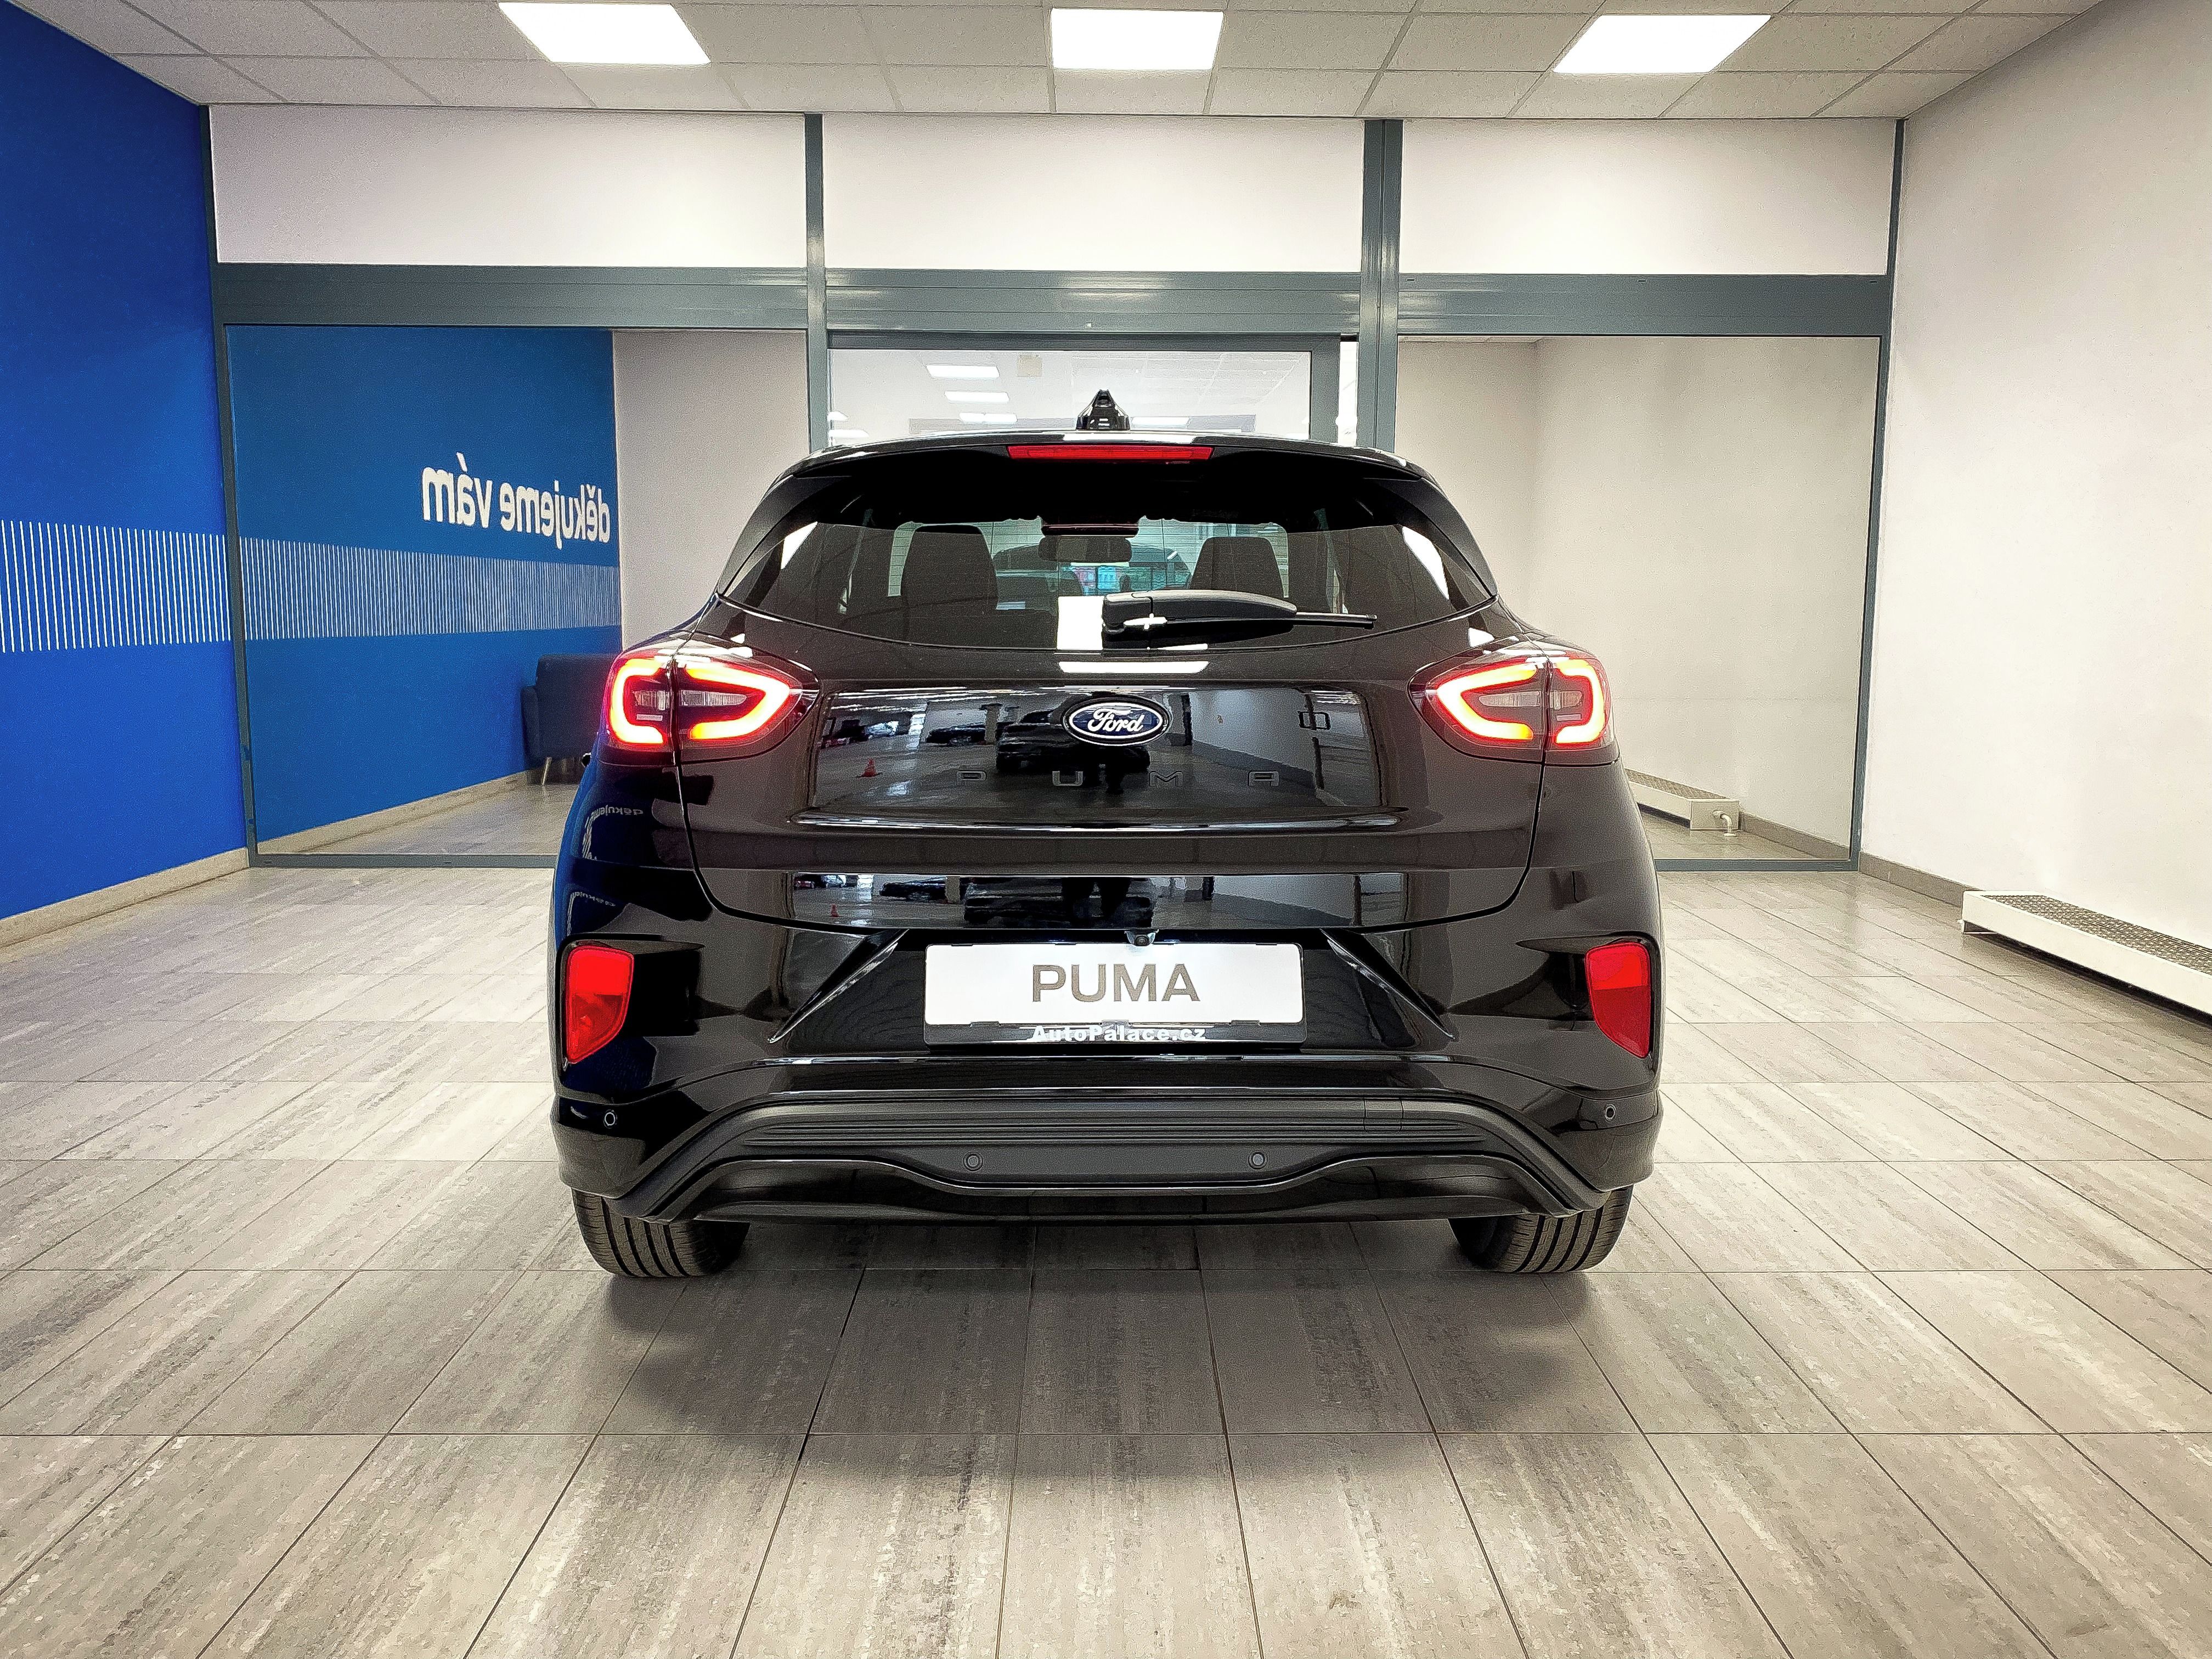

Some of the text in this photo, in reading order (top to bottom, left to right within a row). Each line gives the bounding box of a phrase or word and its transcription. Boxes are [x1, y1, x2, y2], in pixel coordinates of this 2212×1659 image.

[1087, 708, 1145, 732] Ford
[956, 770, 1279, 787] PUMA
[1032, 963, 1201, 1002] PUMA
[1031, 1023, 1206, 1041] AutoPalace.cz
